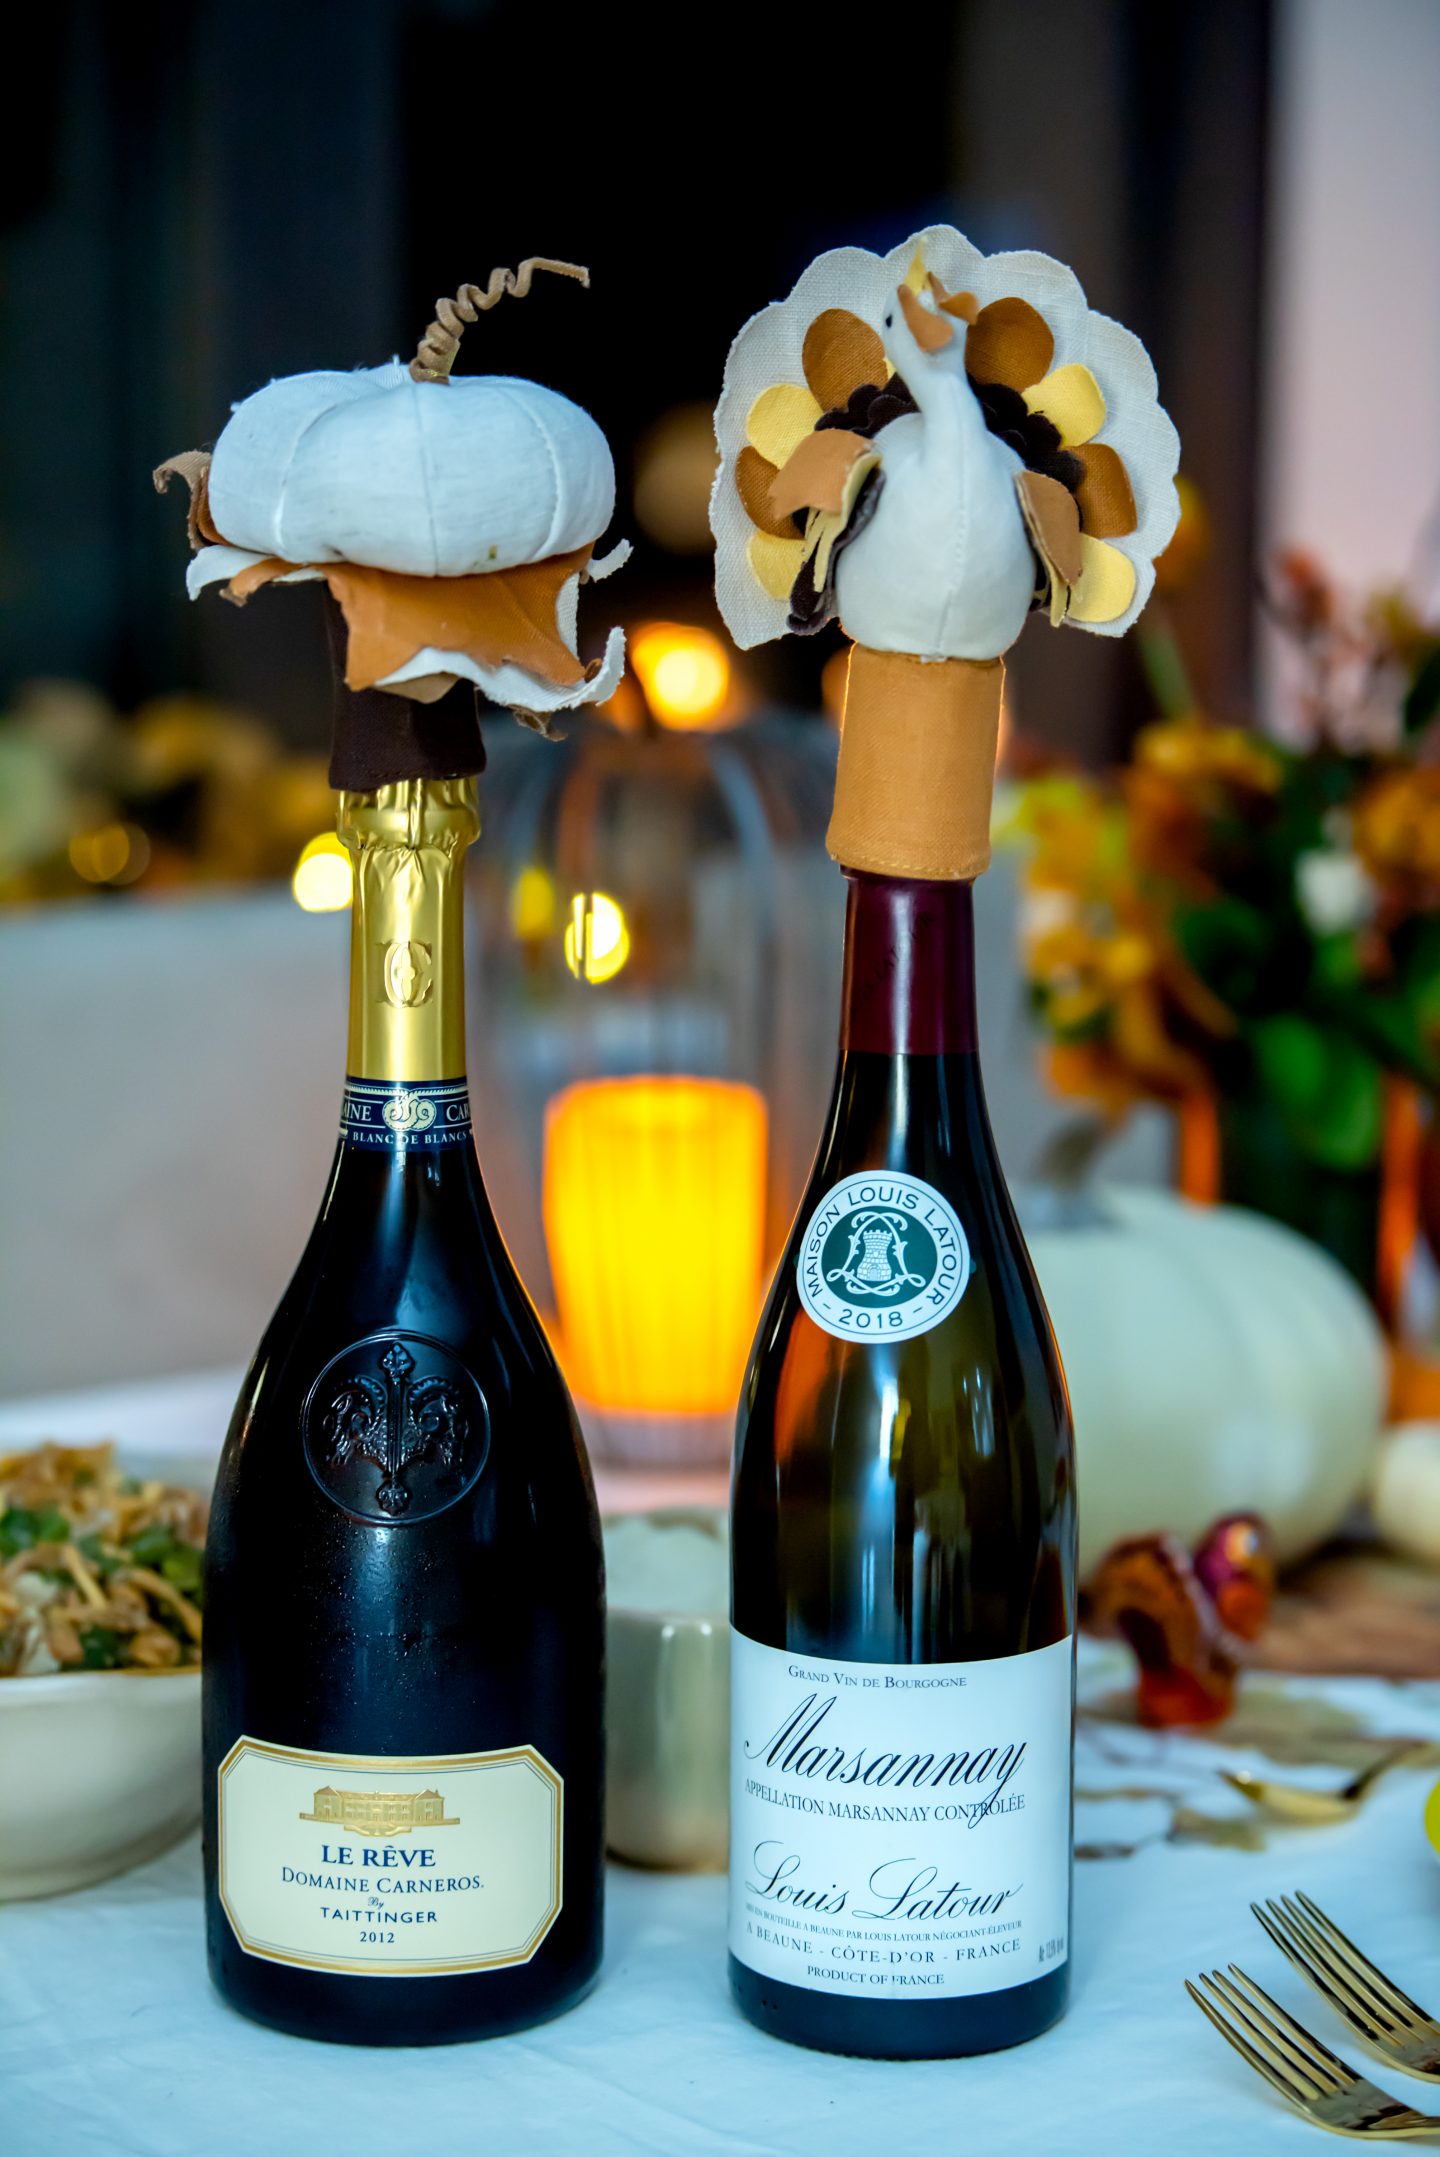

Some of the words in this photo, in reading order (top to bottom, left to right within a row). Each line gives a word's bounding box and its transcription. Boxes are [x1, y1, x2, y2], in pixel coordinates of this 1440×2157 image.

[353, 1131, 394, 1144] BLANC
[425, 1131, 467, 1144] BLANCS
[806, 1204, 841, 1298] MAISON
[847, 1187, 919, 1210] LOUIS
[924, 1208, 958, 1306] LATOUR
[839, 1308, 903, 1328] 2018
[788, 1665, 830, 1683] GRAND
[833, 1672, 858, 1686] VIN
[862, 1678, 881, 1688] DE
[884, 1676, 968, 1689] BOURGOGNE
[743, 1692, 1027, 1829] Marsannay
[744, 1778, 825, 1816] APPELLATION
[828, 1803, 931, 1822] MARSANNAY
[321, 1844, 354, 1865] LE
[362, 1845, 436, 1867] RÊVE
[282, 1866, 370, 1893] DOMAINE
[745, 1841, 850, 1914] Louis
[851, 1858, 1024, 1921] Latour
[320, 1906, 437, 1924] TAITTINGER
[367, 1896, 384, 1910] By
[359, 1931, 395, 1944] 2012
[763, 1910, 801, 1931] BOUTEILLE
[810, 1923, 845, 1939] BEAUNE
[846, 1929, 863, 1941] PAR
[864, 1931, 892, 1942] LOUIS
[893, 1932, 932, 1942] LATOUR
[756, 1925, 813, 1955] BEAUNE
[956, 1938, 1022, 1961] FRANCE
[807, 1964, 867, 1984] PRODUCT
[868, 1973, 889, 1985] OF
[891, 1974, 945, 1986] FRANCE
